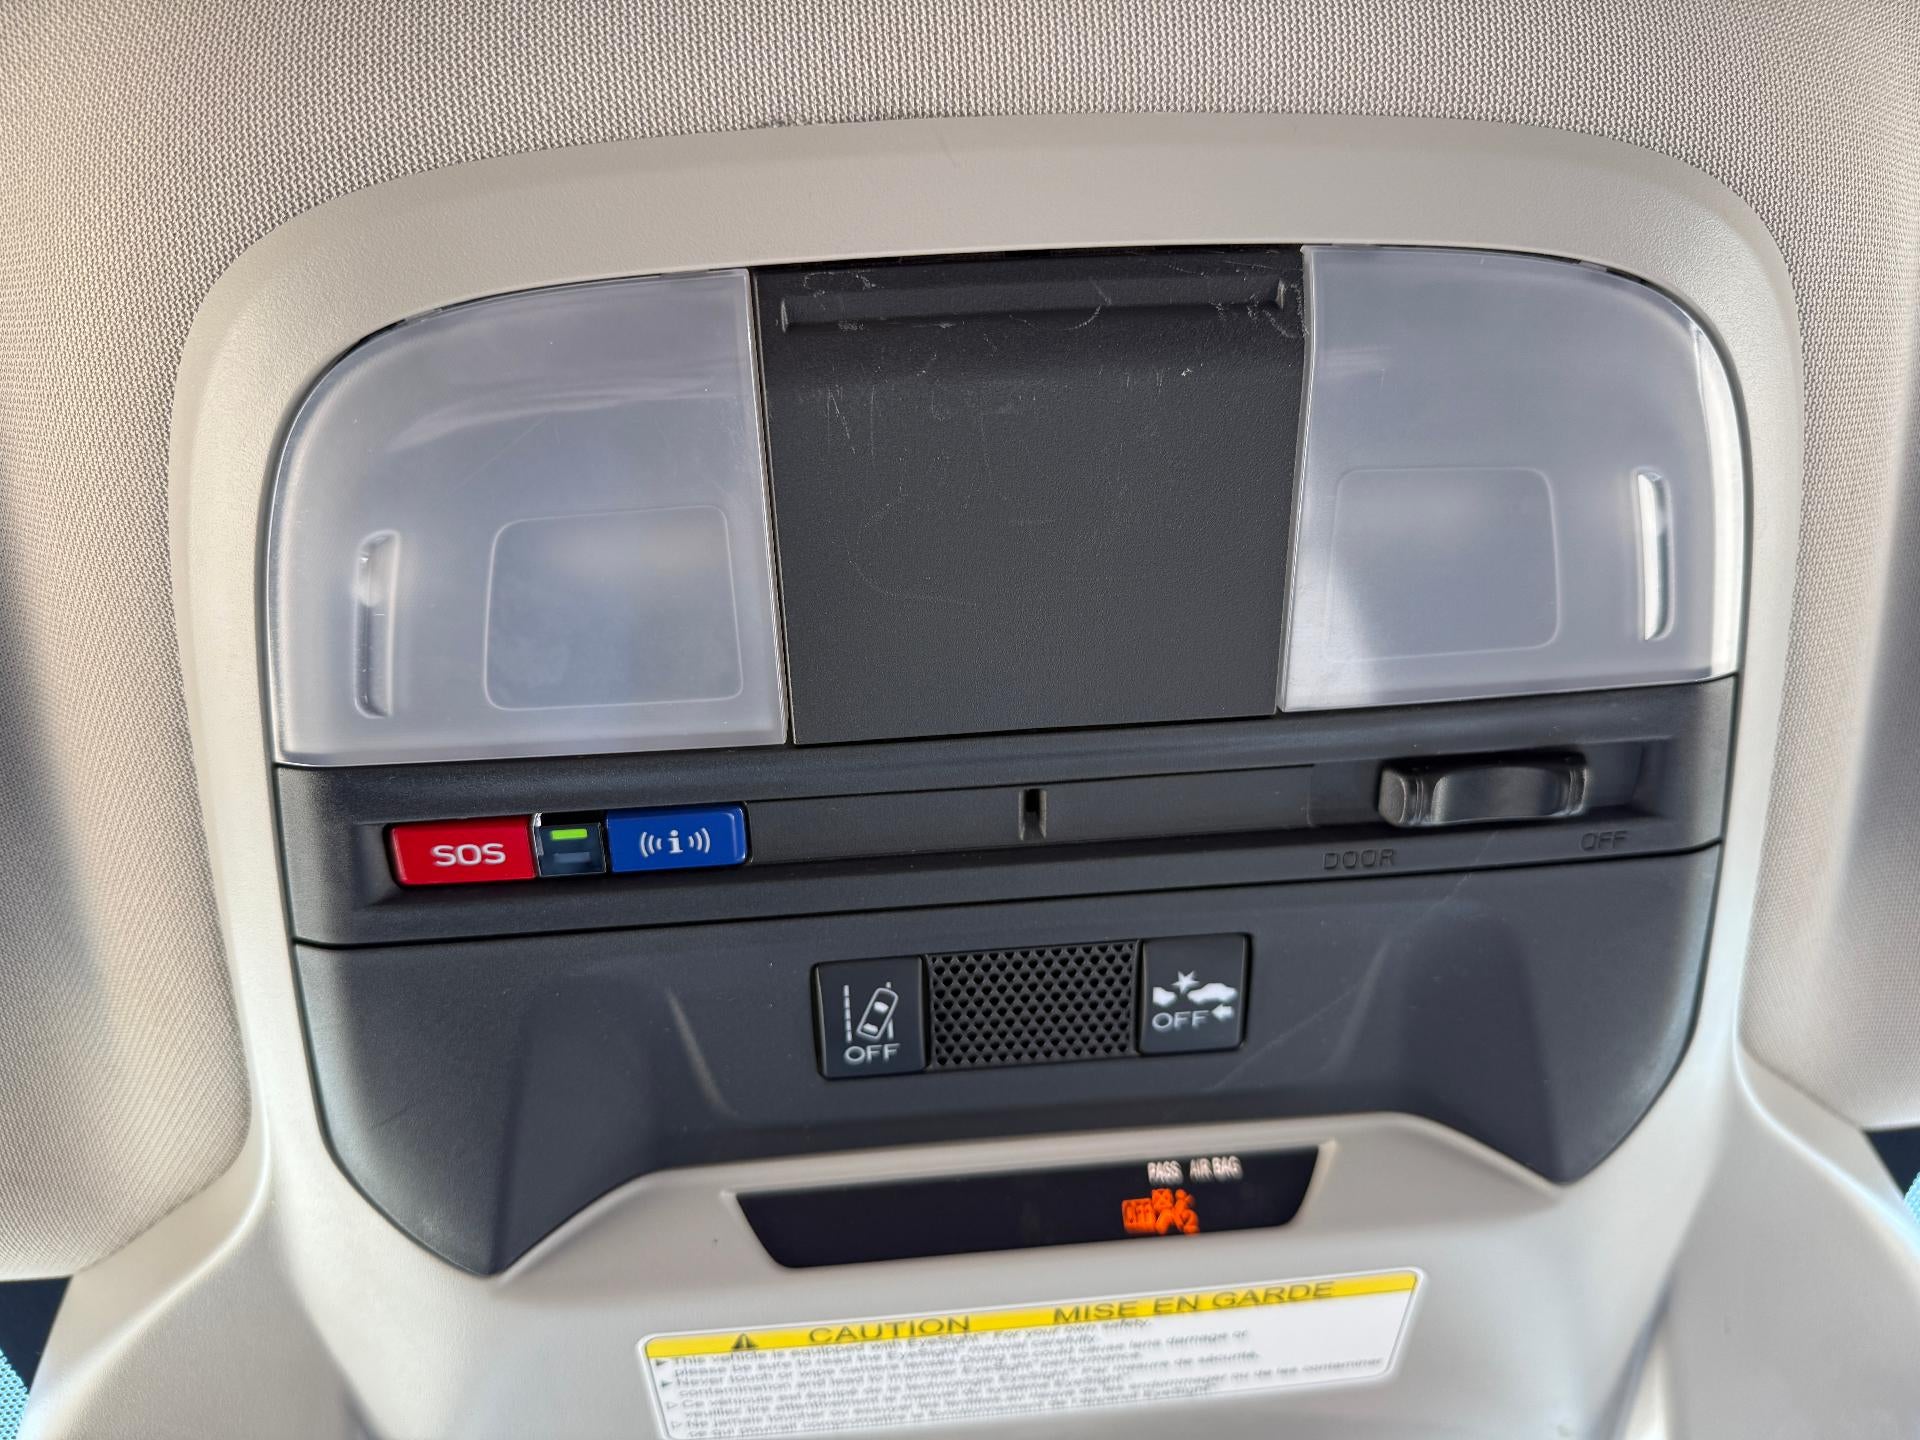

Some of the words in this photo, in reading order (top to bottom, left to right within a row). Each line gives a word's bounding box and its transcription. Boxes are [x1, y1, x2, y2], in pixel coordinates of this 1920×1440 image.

[1580, 830, 1628, 850] OFF
[430, 843, 506, 867] SOS
[1322, 848, 1397, 870] DOOR
[1151, 1009, 1210, 1032] OFF
[843, 1043, 901, 1066] OFF
[1147, 1160, 1184, 1185] PASS
[1189, 1157, 1213, 1182] AIR
[1211, 1155, 1243, 1182] BAG
[1054, 1300, 1138, 1323] MISE
[1152, 1296, 1200, 1314] EN
[1212, 1281, 1335, 1309] GARDE
[808, 1315, 971, 1343] CAUTION
